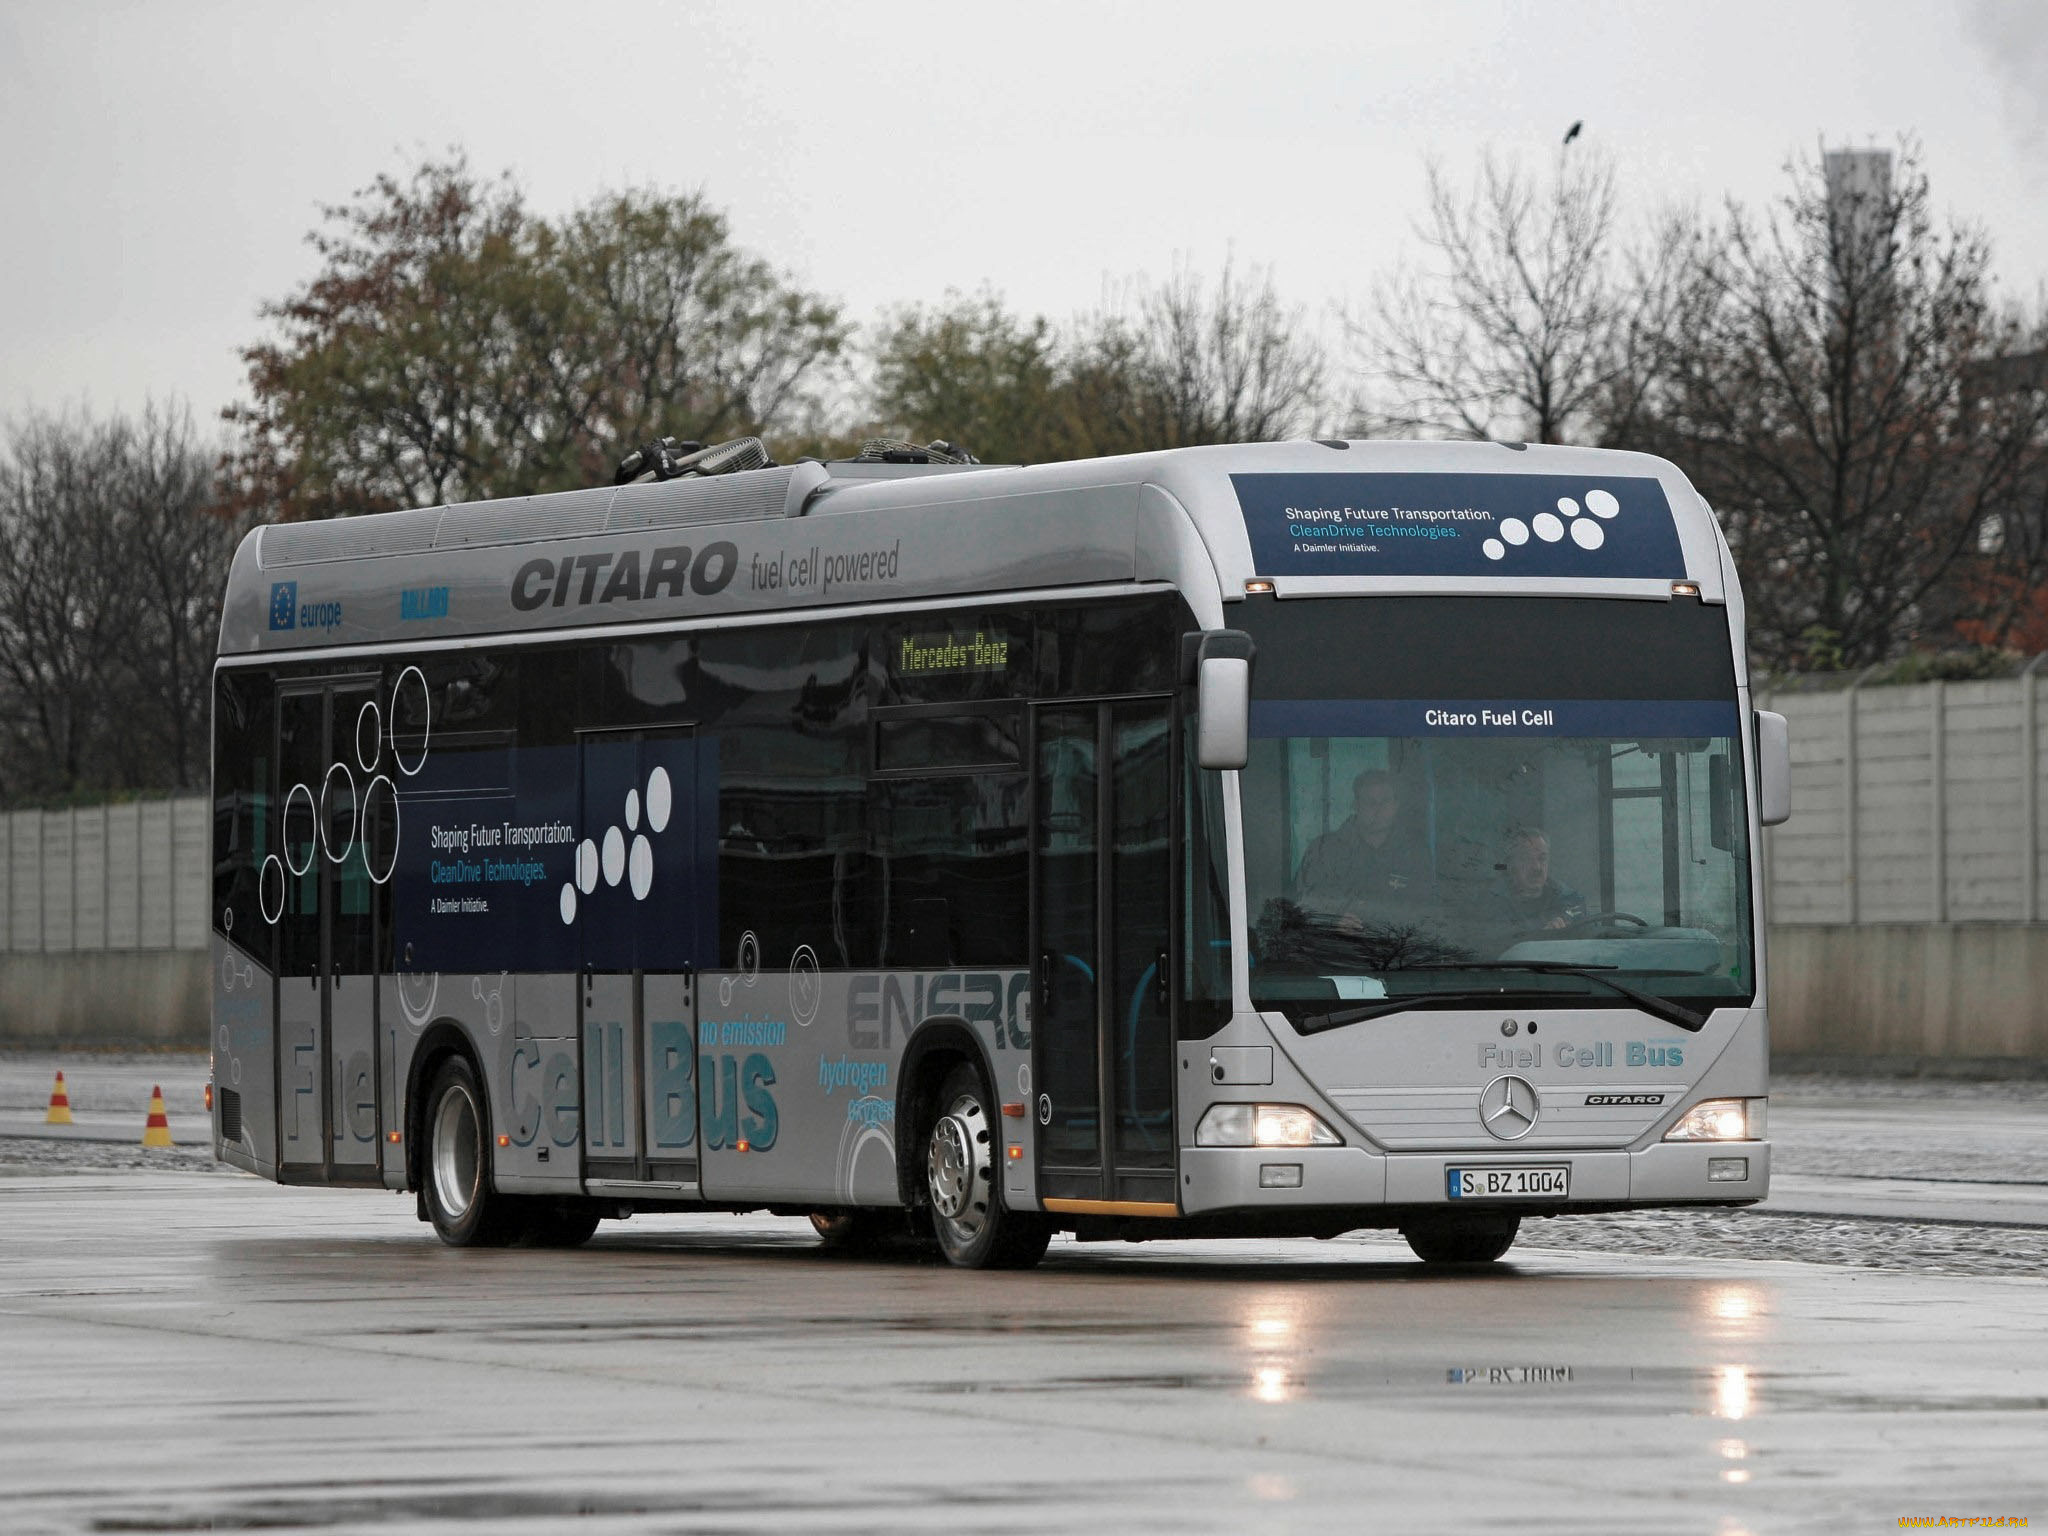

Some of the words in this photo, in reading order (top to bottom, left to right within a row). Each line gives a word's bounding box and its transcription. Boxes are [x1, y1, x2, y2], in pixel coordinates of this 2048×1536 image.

[1285, 507, 1342, 522] Shaping
[1345, 507, 1389, 520] Future
[1391, 507, 1495, 522] Transportation.
[1290, 524, 1364, 537] CleanDrive
[1367, 524, 1460, 540] Technologies.
[1294, 544, 1301, 552] A
[1302, 543, 1337, 552] Daimler
[1339, 543, 1379, 552] Initiative.
[510, 541, 739, 612] CITARO
[751, 552, 783, 591] fuel
[788, 546, 819, 588] cell
[823, 539, 900, 595] powered
[300, 602, 342, 634] europe
[902, 632, 1007, 670] Mercedes-Benz
[1425, 710, 1477, 726] Citaro
[1481, 710, 1517, 726] Fuel
[1521, 710, 1554, 726] Cell
[431, 825, 469, 854] Shaping
[471, 823, 501, 847] Future
[503, 820, 575, 851] Transportation.
[431, 859, 481, 883] CleanDrive
[483, 857, 546, 887] Technologies.
[431, 899, 436, 913] A
[437, 898, 460, 913] Daimler
[462, 897, 489, 913] Initiative.
[700, 1020, 718, 1046] no
[722, 1013, 786, 1047] emission
[1478, 1042, 1542, 1068] Fuel
[1553, 1041, 1612, 1068] Cell
[1625, 1041, 1684, 1067] Bus
[498, 1021, 625, 1147] Cell
[652, 1021, 779, 1152] Bus
[818, 1054, 888, 1096] hydrogen
[1588, 1095, 1660, 1104] CITARO
[1463, 1173, 1474, 1193] S
[1488, 1173, 1512, 1193] BZ
[1517, 1172, 1564, 1193] 1004
